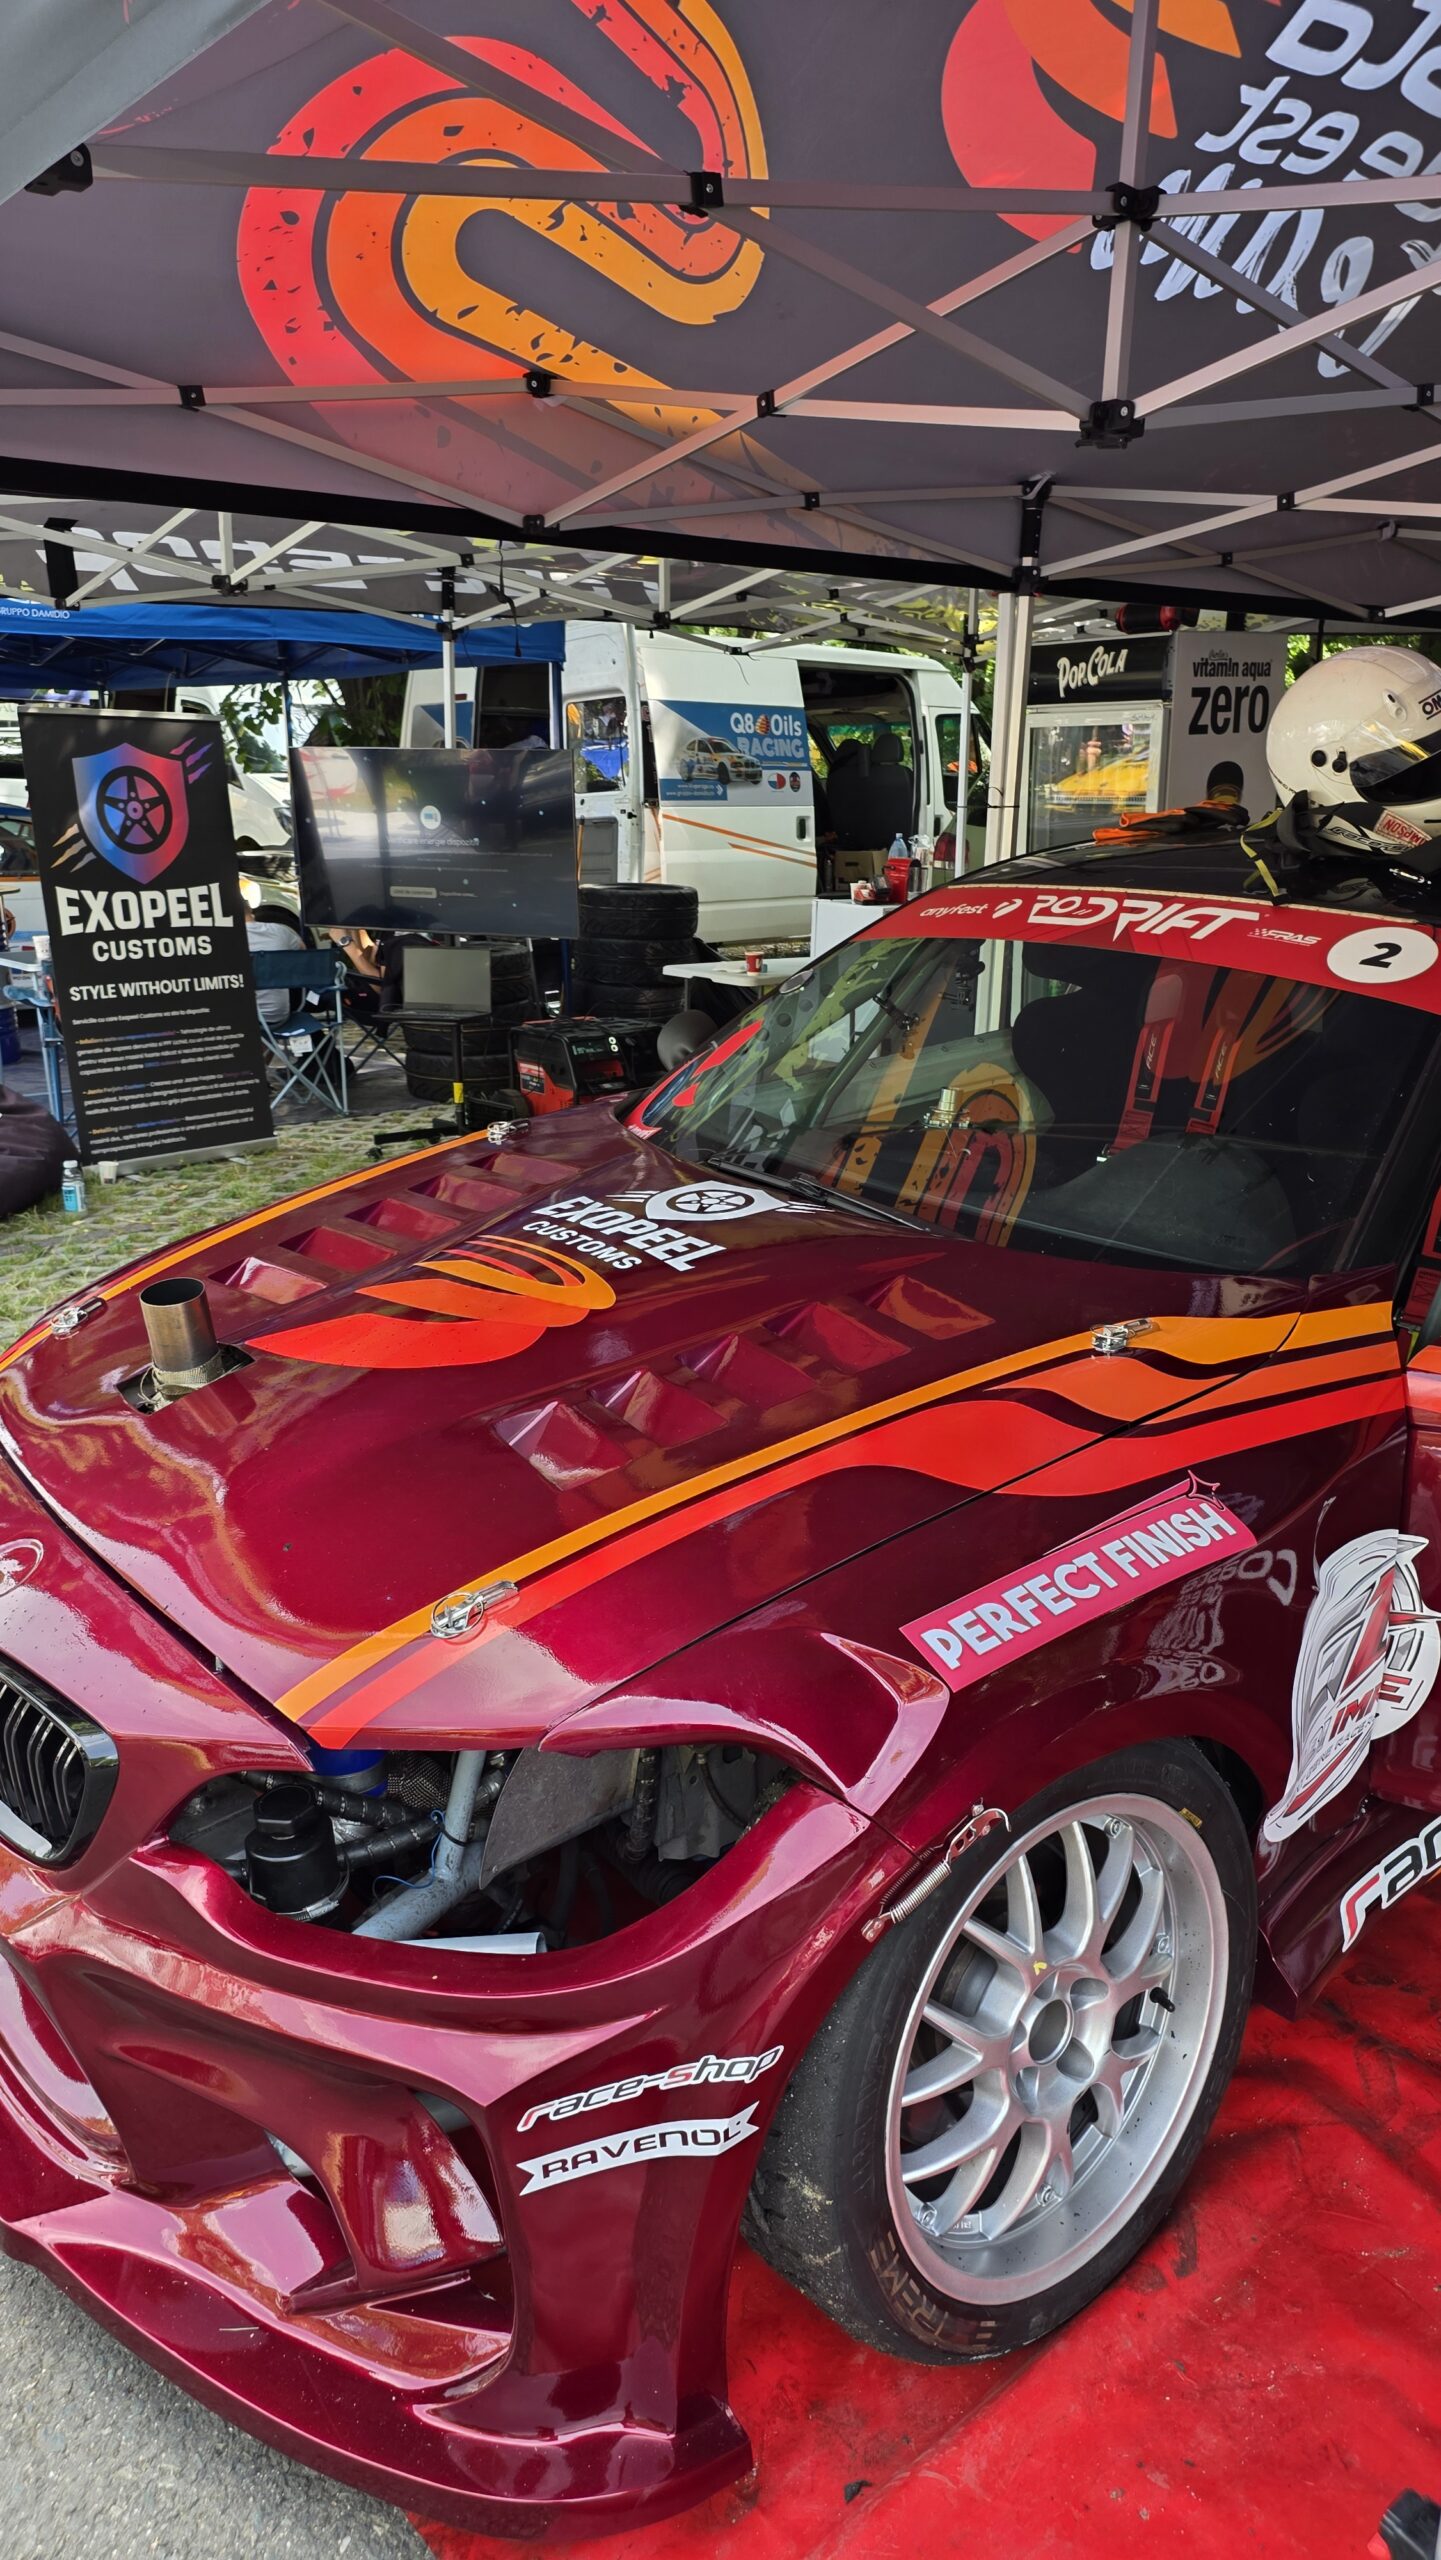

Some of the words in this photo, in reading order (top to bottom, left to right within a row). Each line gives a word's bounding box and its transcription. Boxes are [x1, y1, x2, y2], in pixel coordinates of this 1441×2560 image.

[0, 607, 30, 616] RUPPO
[31, 609, 70, 619] DAMIDIO
[1242, 661, 1271, 681] aqua
[730, 712, 754, 734] Q8
[770, 713, 802, 736] Oils
[1188, 685, 1269, 735] zero
[737, 737, 804, 758] RACING
[1383, 818, 1425, 846] IMPSON
[55, 882, 234, 936] EXOPEEL
[920, 902, 988, 918] anyfest
[92, 935, 213, 962] CUSTOMS
[1358, 942, 1403, 969] 2
[69, 983, 118, 1002] STYLE
[118, 978, 192, 998] WITHOUT
[194, 973, 245, 992] LIMITS!
[522, 1220, 643, 1270] CUSTOMS
[532, 1196, 727, 1272] EXOPEEL
[921, 1551, 1118, 1671] PERFECT
[1100, 1503, 1237, 1578] FINISH
[519, 2046, 782, 2130] race-shop
